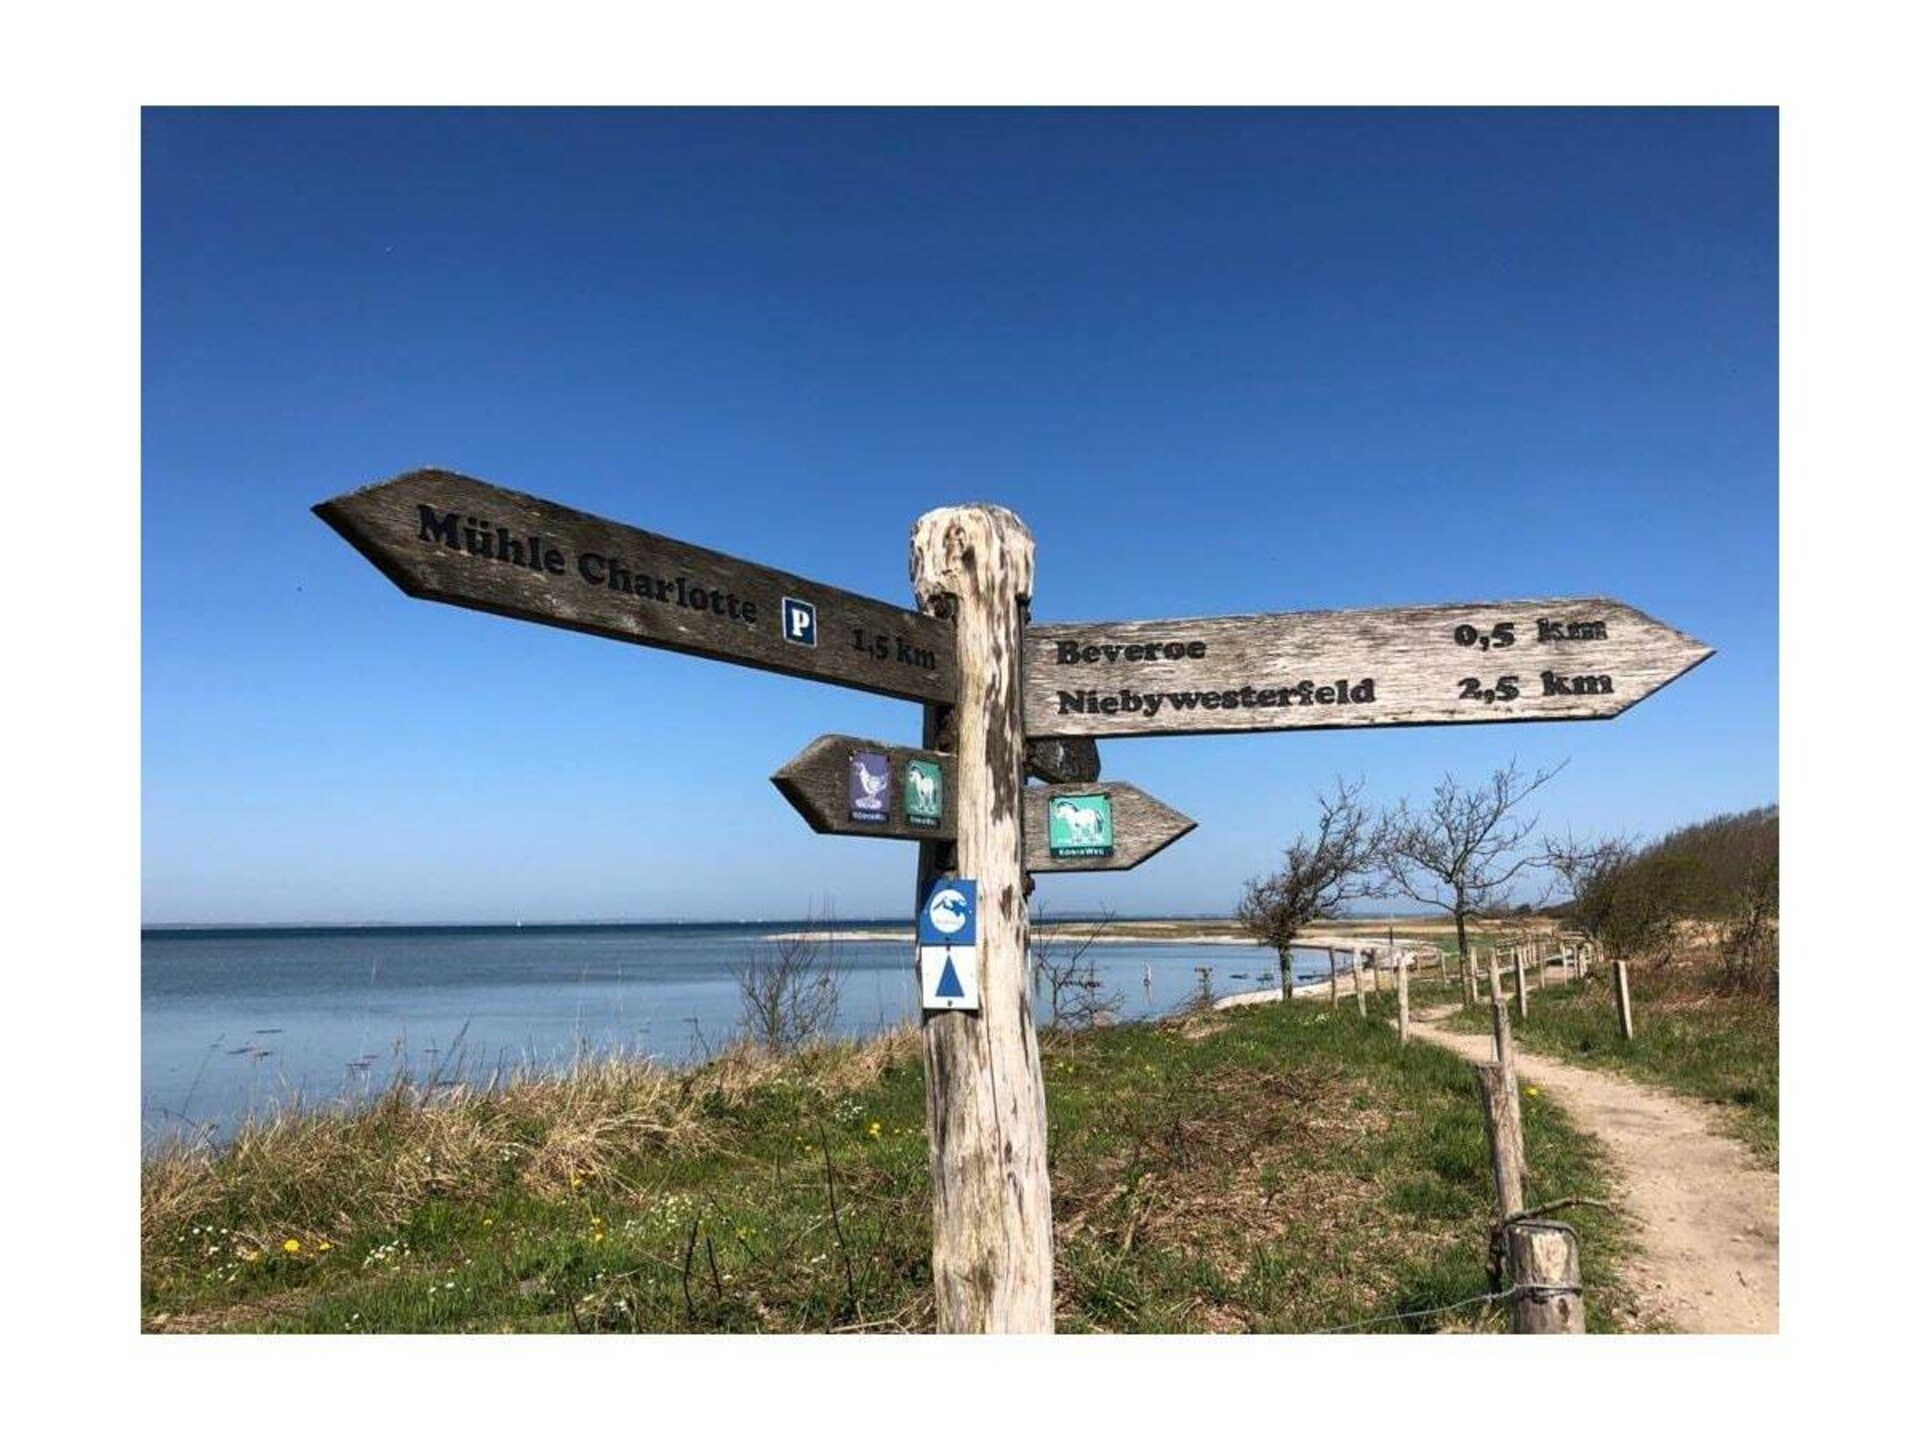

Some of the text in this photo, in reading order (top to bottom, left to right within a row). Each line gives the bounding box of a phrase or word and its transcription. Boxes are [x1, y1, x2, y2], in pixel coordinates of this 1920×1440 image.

[417, 503, 937, 672] Mühle Charlotte P 1,5 km
[1055, 617, 1608, 665] Beveroe 0,5 km
[1056, 670, 1614, 718] Niebywesterfeld 2,5 km
